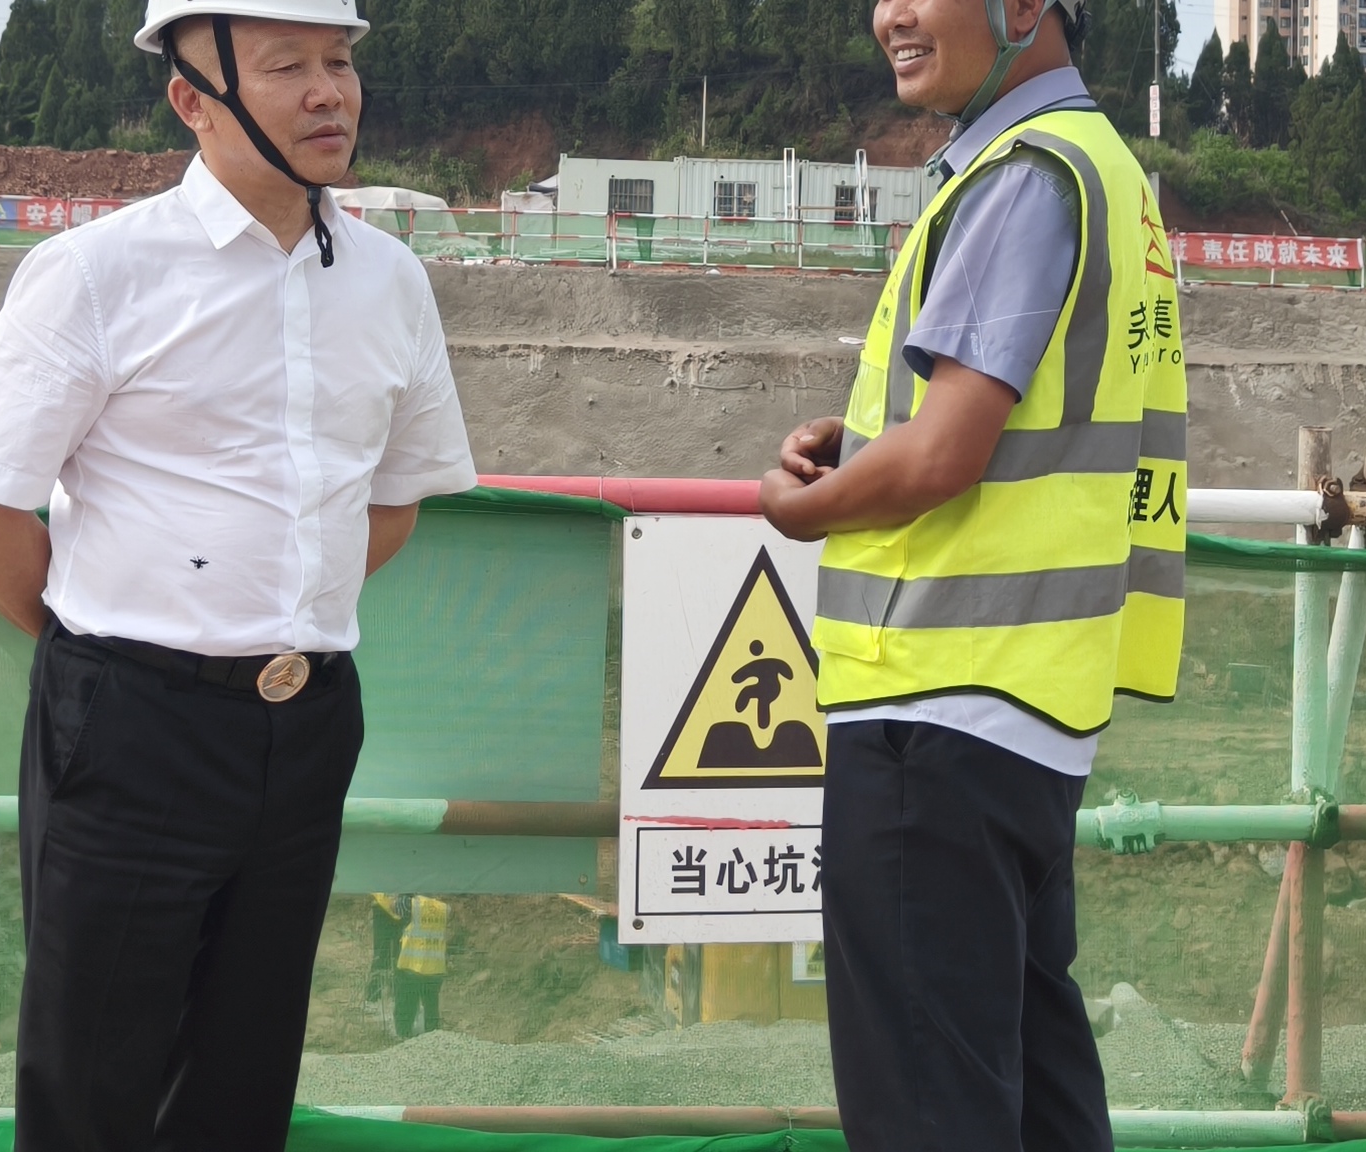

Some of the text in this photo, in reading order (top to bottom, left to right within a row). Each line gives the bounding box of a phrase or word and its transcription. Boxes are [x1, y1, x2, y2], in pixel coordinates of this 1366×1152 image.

[1202, 239, 1349, 268] 责任成就未来
